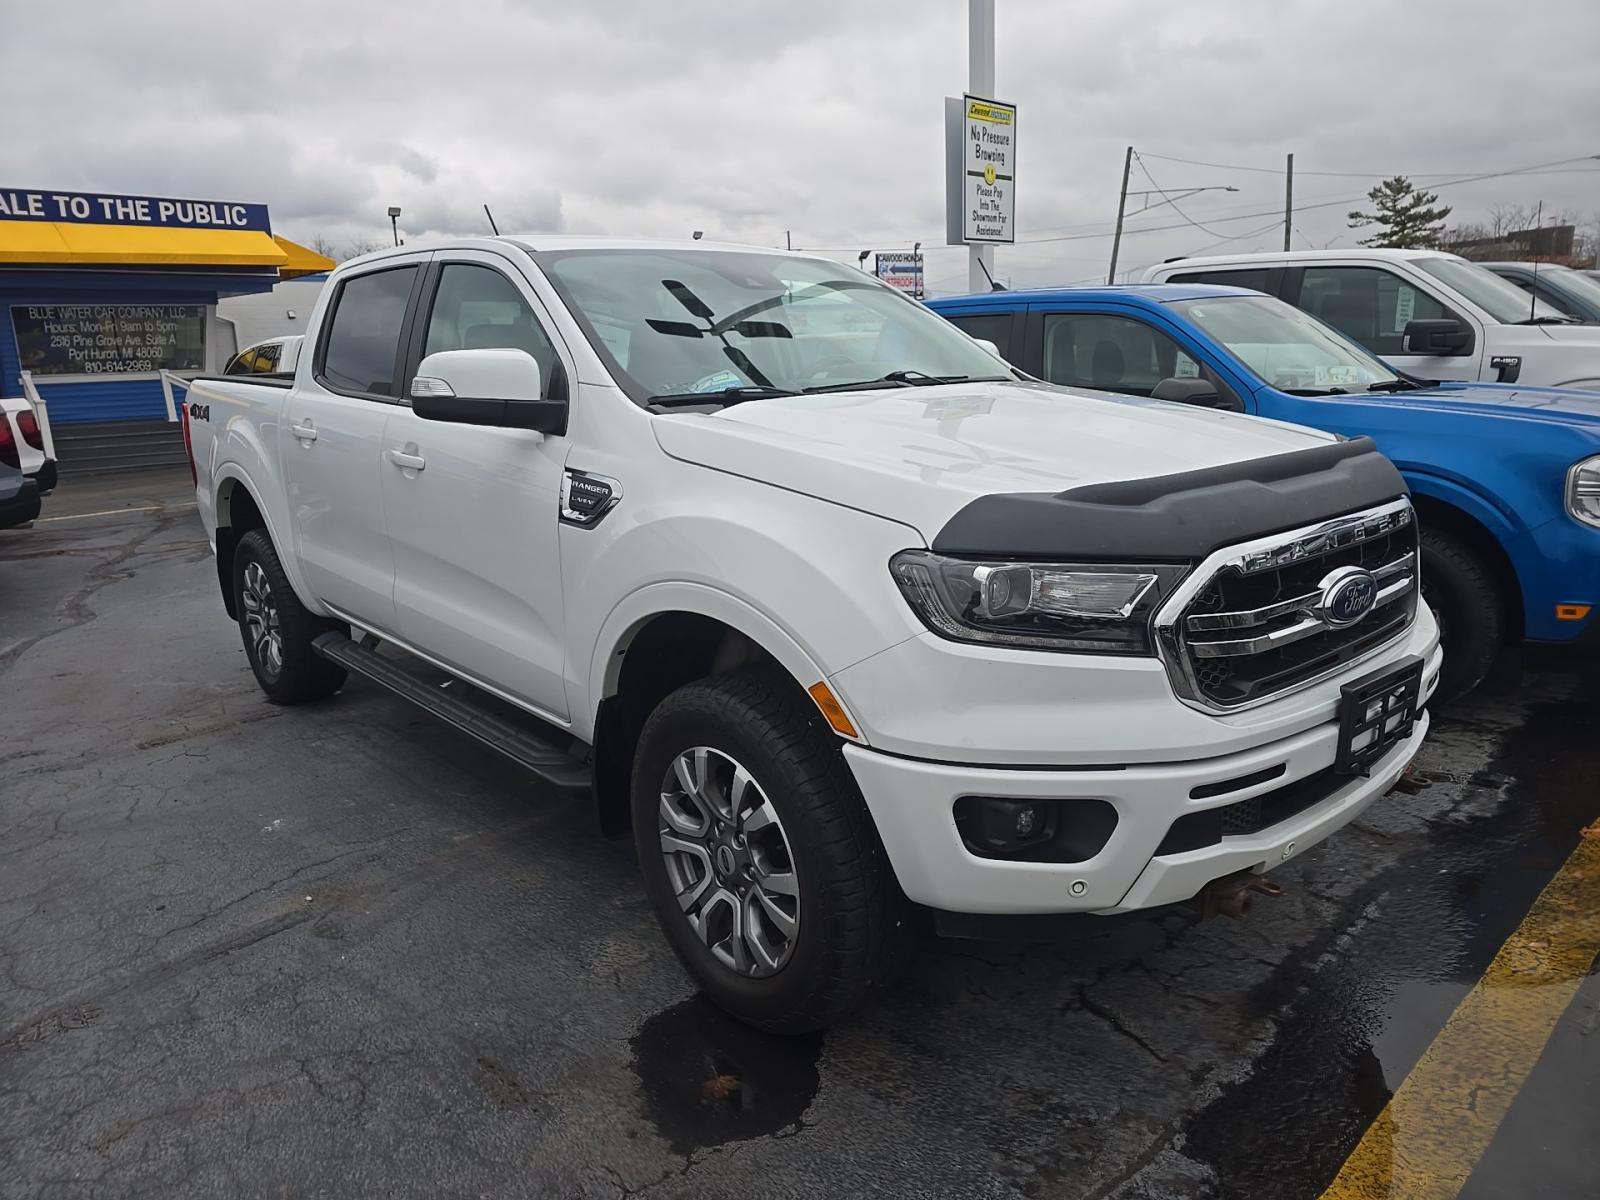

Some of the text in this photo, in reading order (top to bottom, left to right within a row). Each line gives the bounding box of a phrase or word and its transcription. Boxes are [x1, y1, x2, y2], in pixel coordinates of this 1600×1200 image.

[971, 125, 1009, 145] No Pressure
[976, 143, 1004, 166] Browsing
[976, 184, 1003, 200] Please Pop
[53, 195, 90, 219] TO
[98, 198, 151, 221] THE
[159, 202, 248, 226] PUBLIC
[979, 198, 1000, 211] Into The
[972, 209, 1007, 224] Showroom For
[28, 306, 56, 319] BLUE
[57, 306, 93, 319] WATER
[94, 306, 117, 319] CAR
[169, 306, 186, 319] LLC
[79, 320, 118, 332] Mon-Fri
[120, 320, 142, 332] 9am
[144, 321, 154, 331] to
[156, 320, 177, 334] 5pm
[73, 334, 93, 346] Pine
[95, 334, 122, 346] Grove
[145, 333, 167, 345] Suite
[169, 334, 176, 345] A
[68, 348, 89, 360] Port
[122, 346, 134, 358] MI
[136, 347, 163, 359] 48060
[85, 360, 152, 373] 810-614-2969
[572, 480, 609, 495] RANGER
[1248, 510, 1412, 568] RANGER
[1344, 583, 1373, 615] Ford
